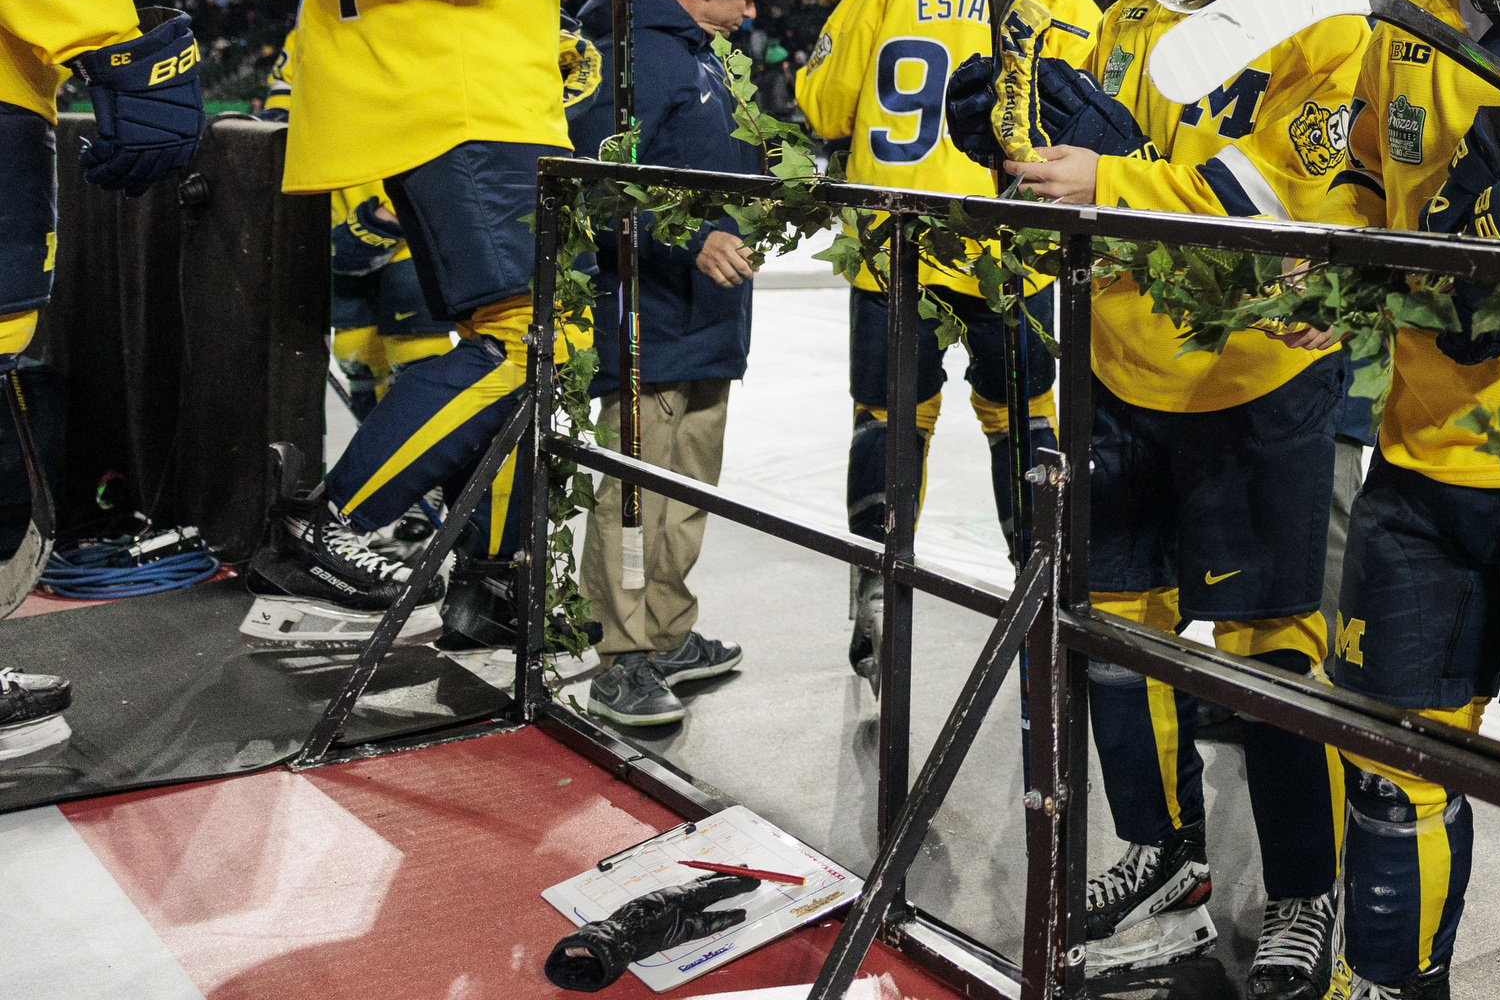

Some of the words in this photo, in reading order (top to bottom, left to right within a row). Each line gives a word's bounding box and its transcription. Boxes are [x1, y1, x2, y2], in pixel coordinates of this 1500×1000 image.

[868, 36, 953, 167] 9
[309, 565, 358, 596] BAUER
[1335, 609, 1366, 669] M
[1148, 867, 1197, 916] CCM
